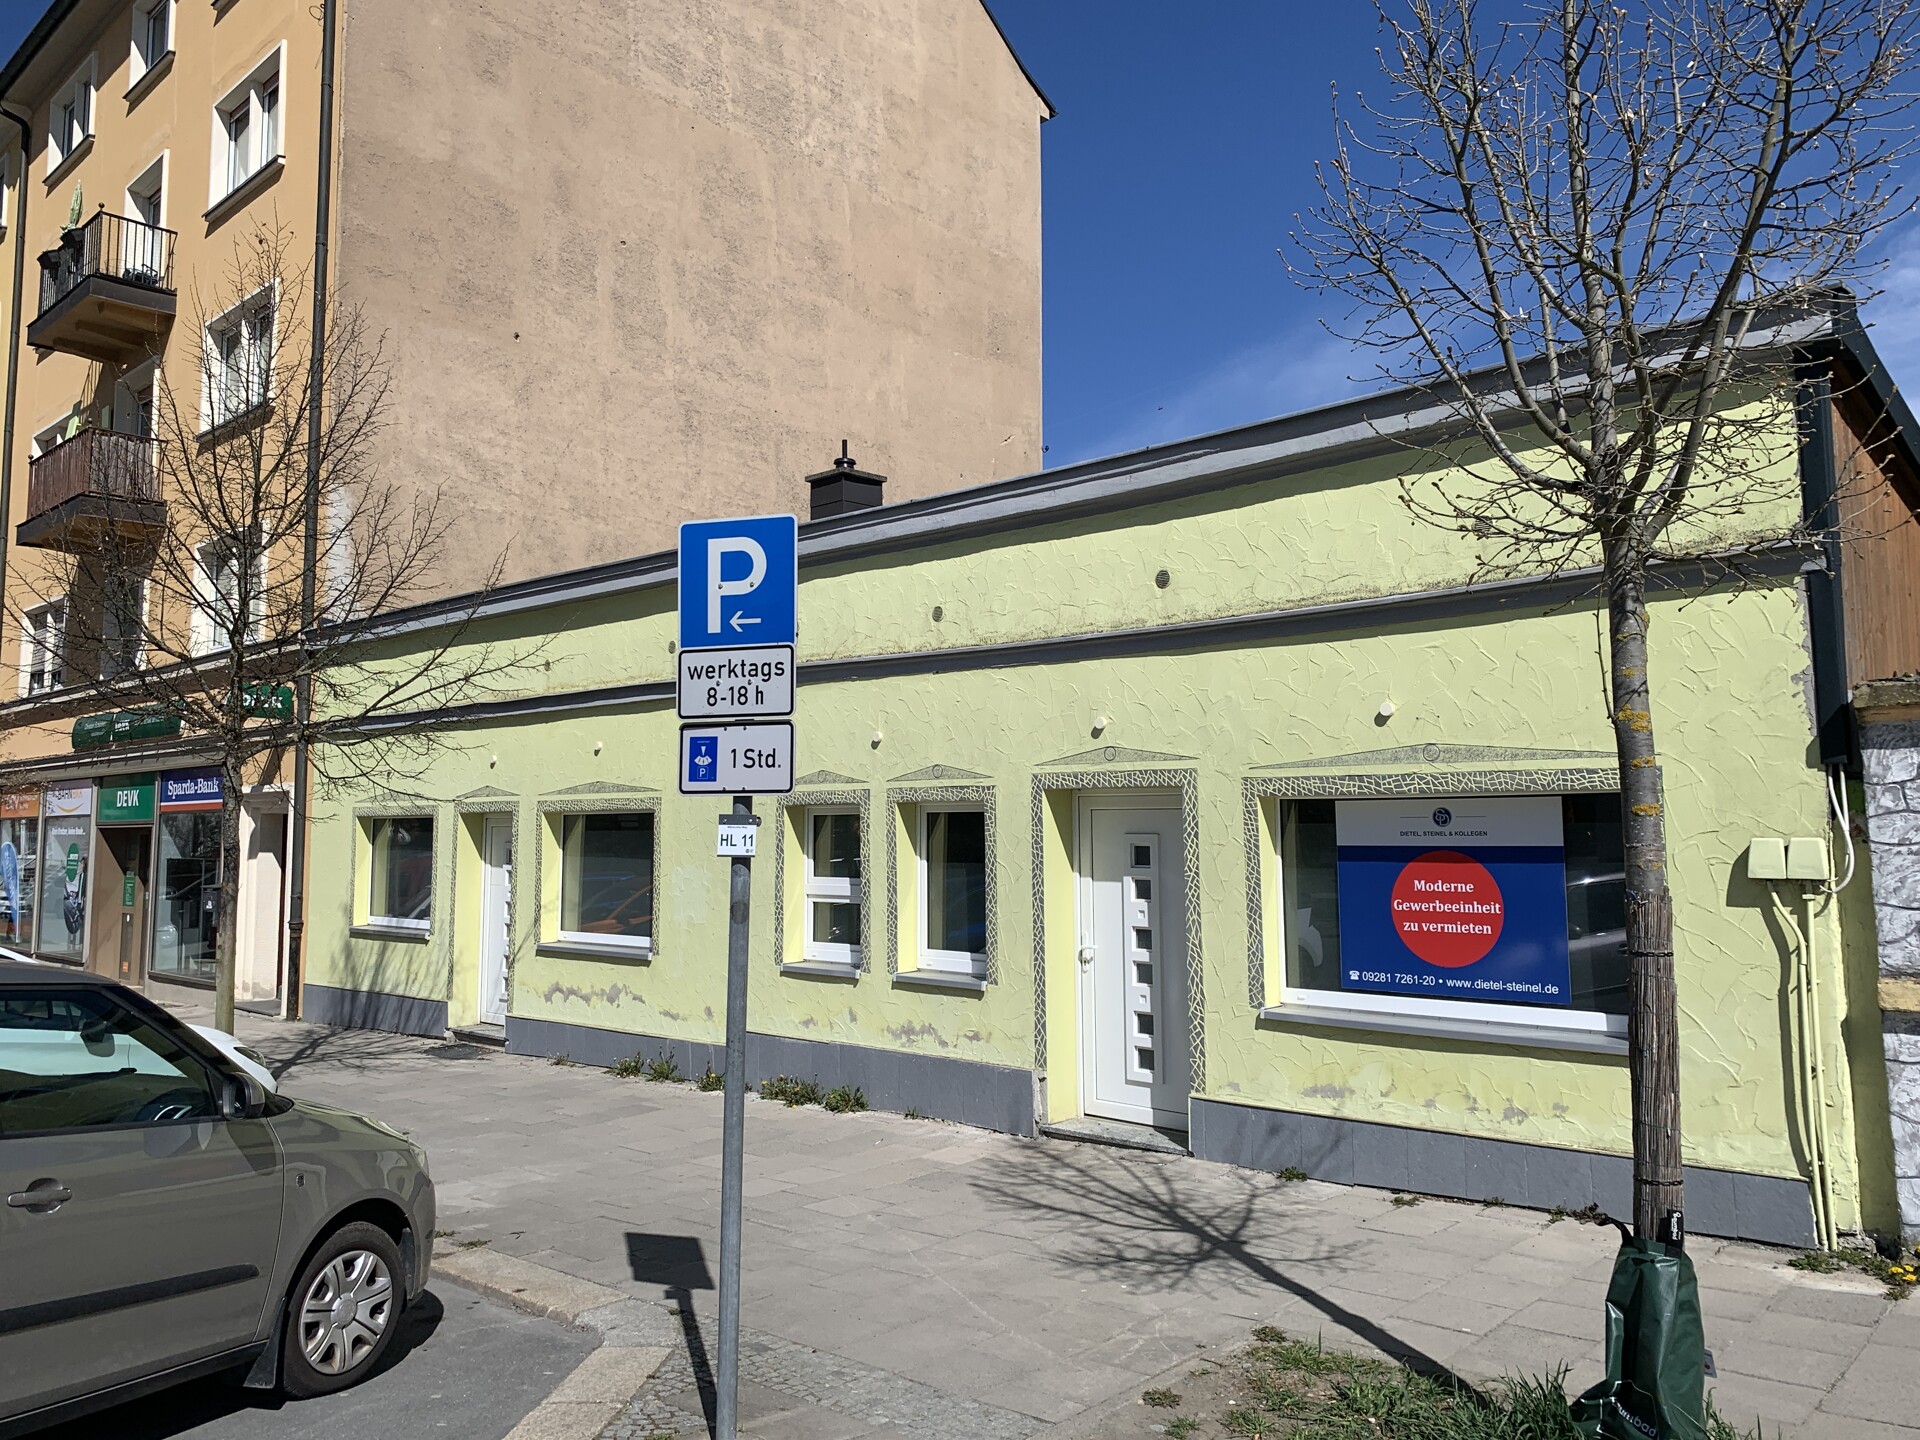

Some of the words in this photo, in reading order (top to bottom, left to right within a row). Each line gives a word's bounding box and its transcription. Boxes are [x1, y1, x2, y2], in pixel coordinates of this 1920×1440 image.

[707, 536, 767, 634] P
[687, 659, 785, 682] werktags
[707, 685, 749, 707] 8-18
[755, 685, 764, 705] h
[730, 748, 737, 769] 1
[743, 748, 782, 769] Std.
[699, 768, 706, 777] P
[168, 777, 219, 799] Sparda-Bank
[116, 790, 139, 807] DEVK
[720, 834, 737, 847] HL
[741, 834, 754, 847] 11
[1413, 880, 1474, 893] Moderne
[1393, 899, 1501, 914] Gewerbeeinheit
[1403, 921, 1419, 932] zu
[1421, 922, 1492, 934] vermieten
[1362, 971, 1391, 983] 09281
[1394, 973, 1436, 985] 7261-20
[1446, 978, 1559, 994] www.dietel-steinel.de
